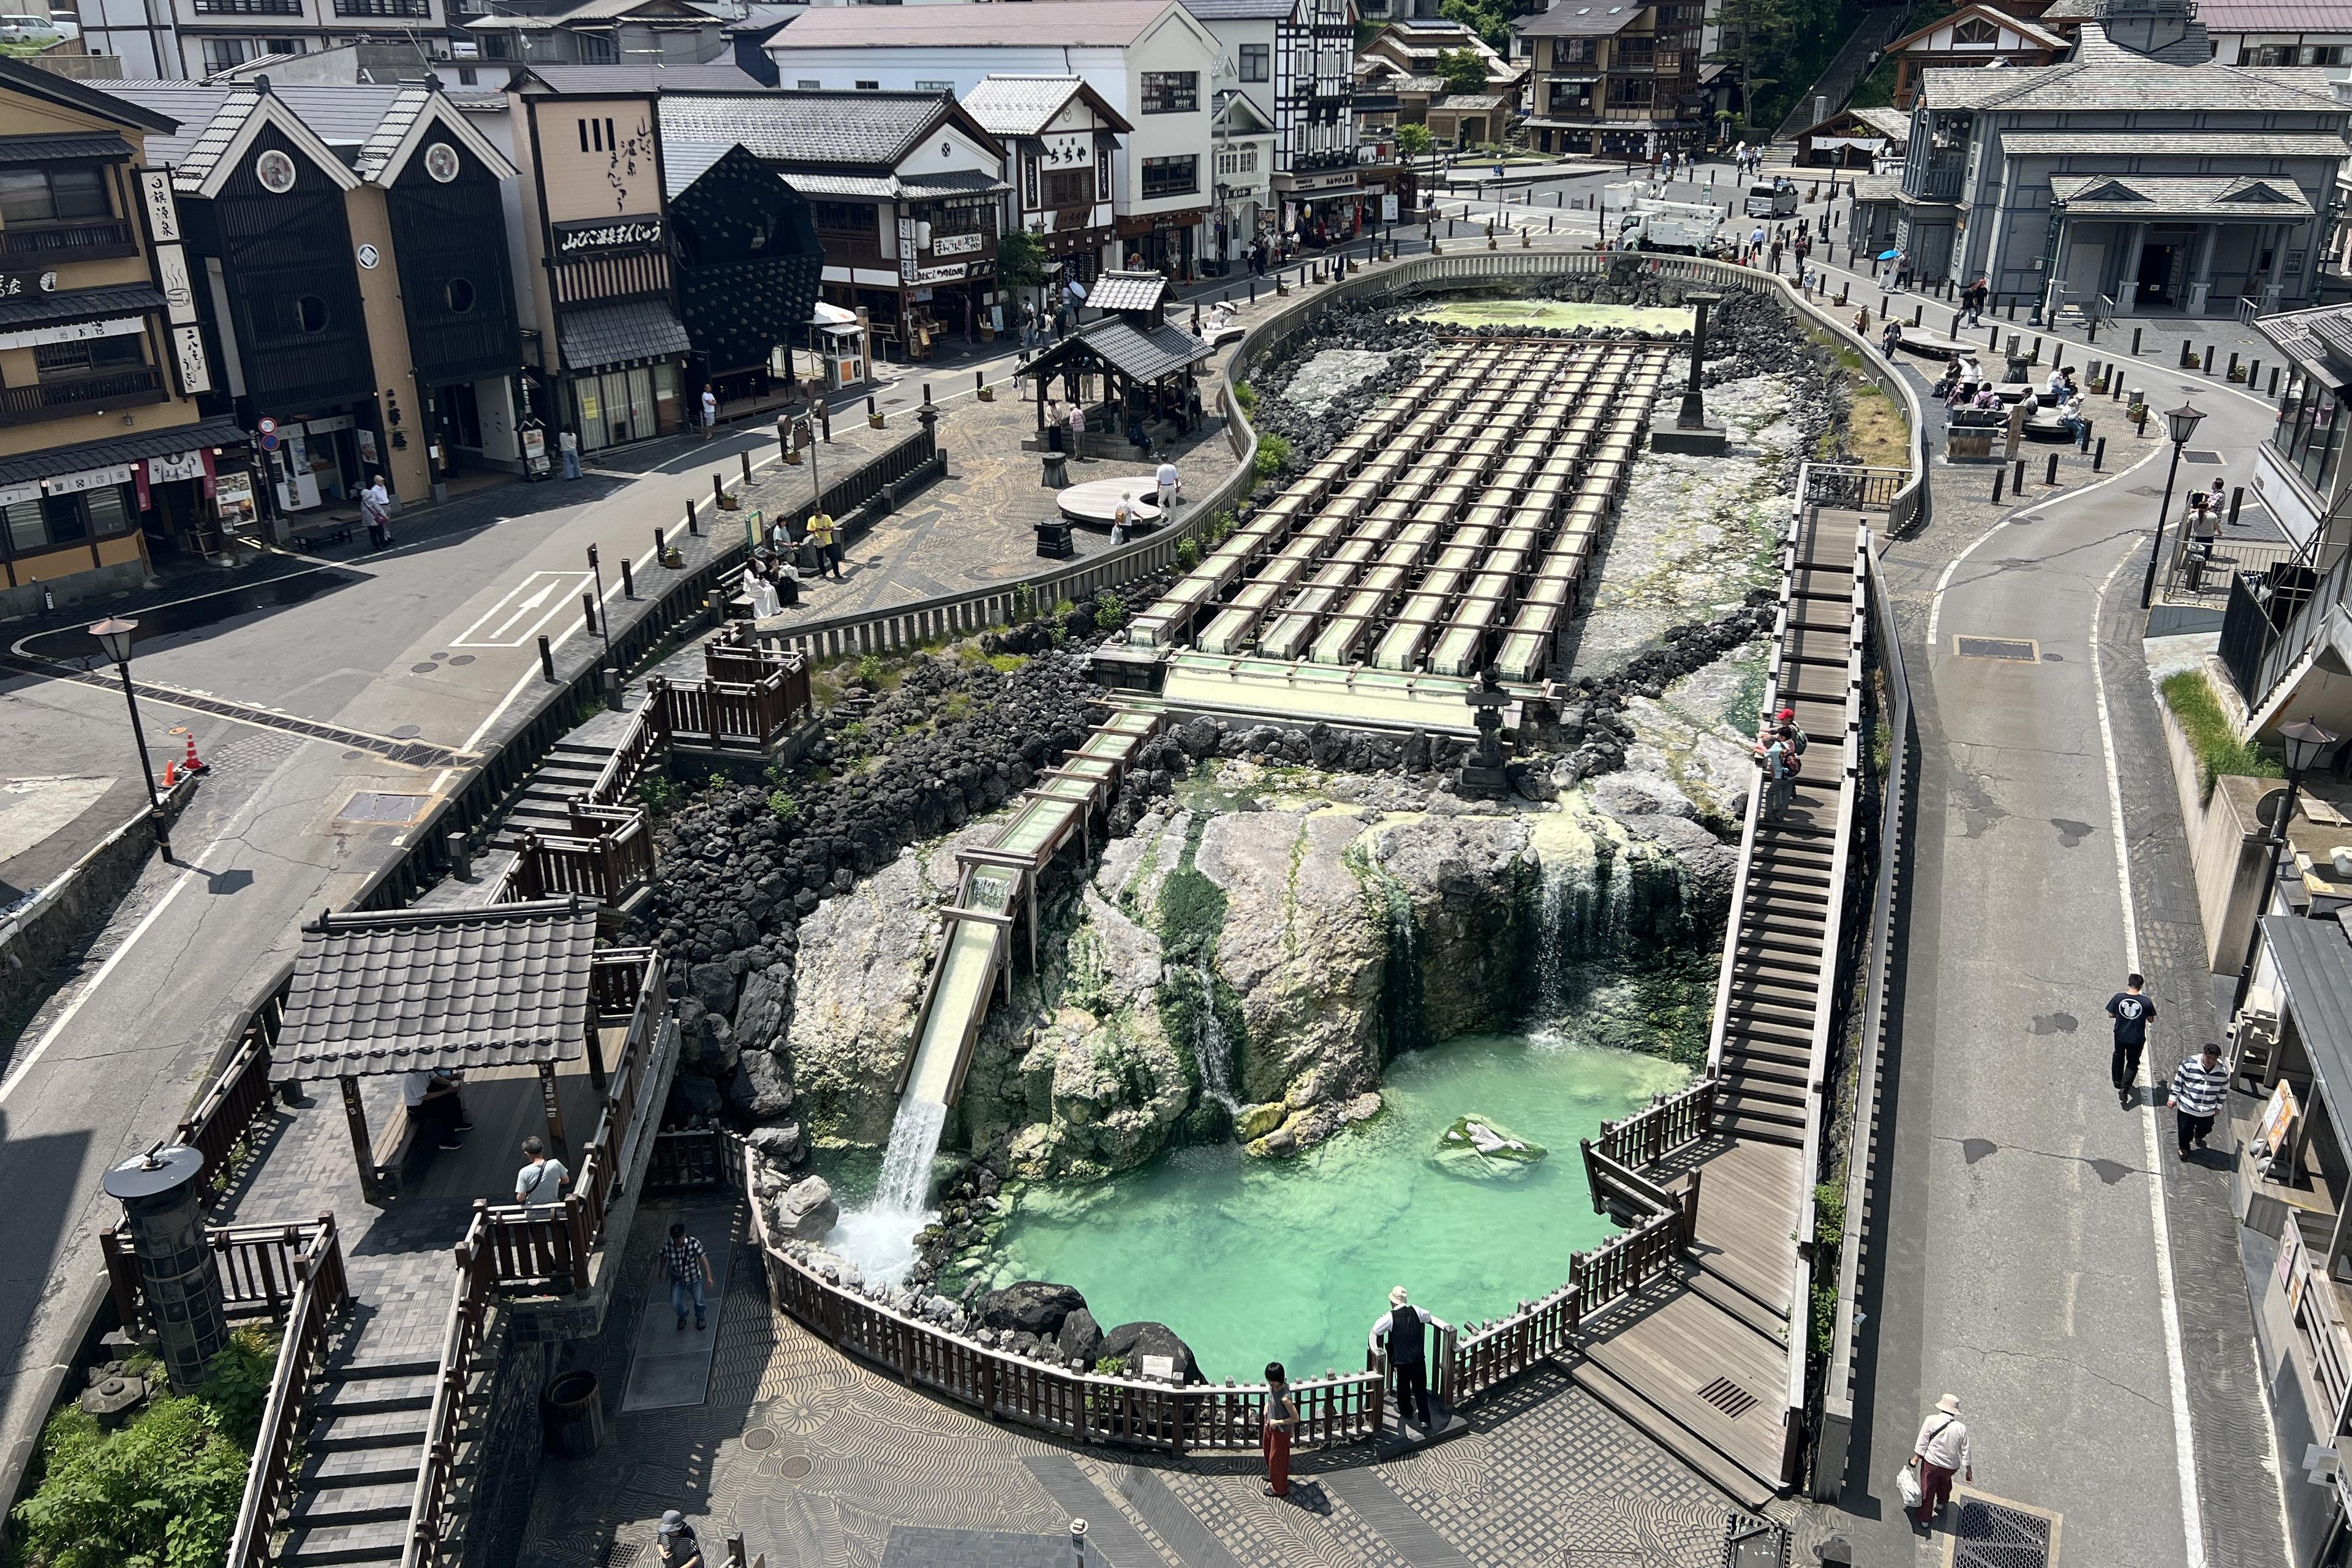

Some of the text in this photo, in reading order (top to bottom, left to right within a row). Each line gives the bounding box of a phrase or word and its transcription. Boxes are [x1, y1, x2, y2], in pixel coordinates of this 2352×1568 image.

[1059, 137, 1076, 146] 本家
[1050, 146, 1086, 164] ちちや
[149, 175, 175, 236] 白旗源泉
[561, 221, 662, 251] 山びこ温泉まんじゅう
[935, 239, 961, 255] まんてん
